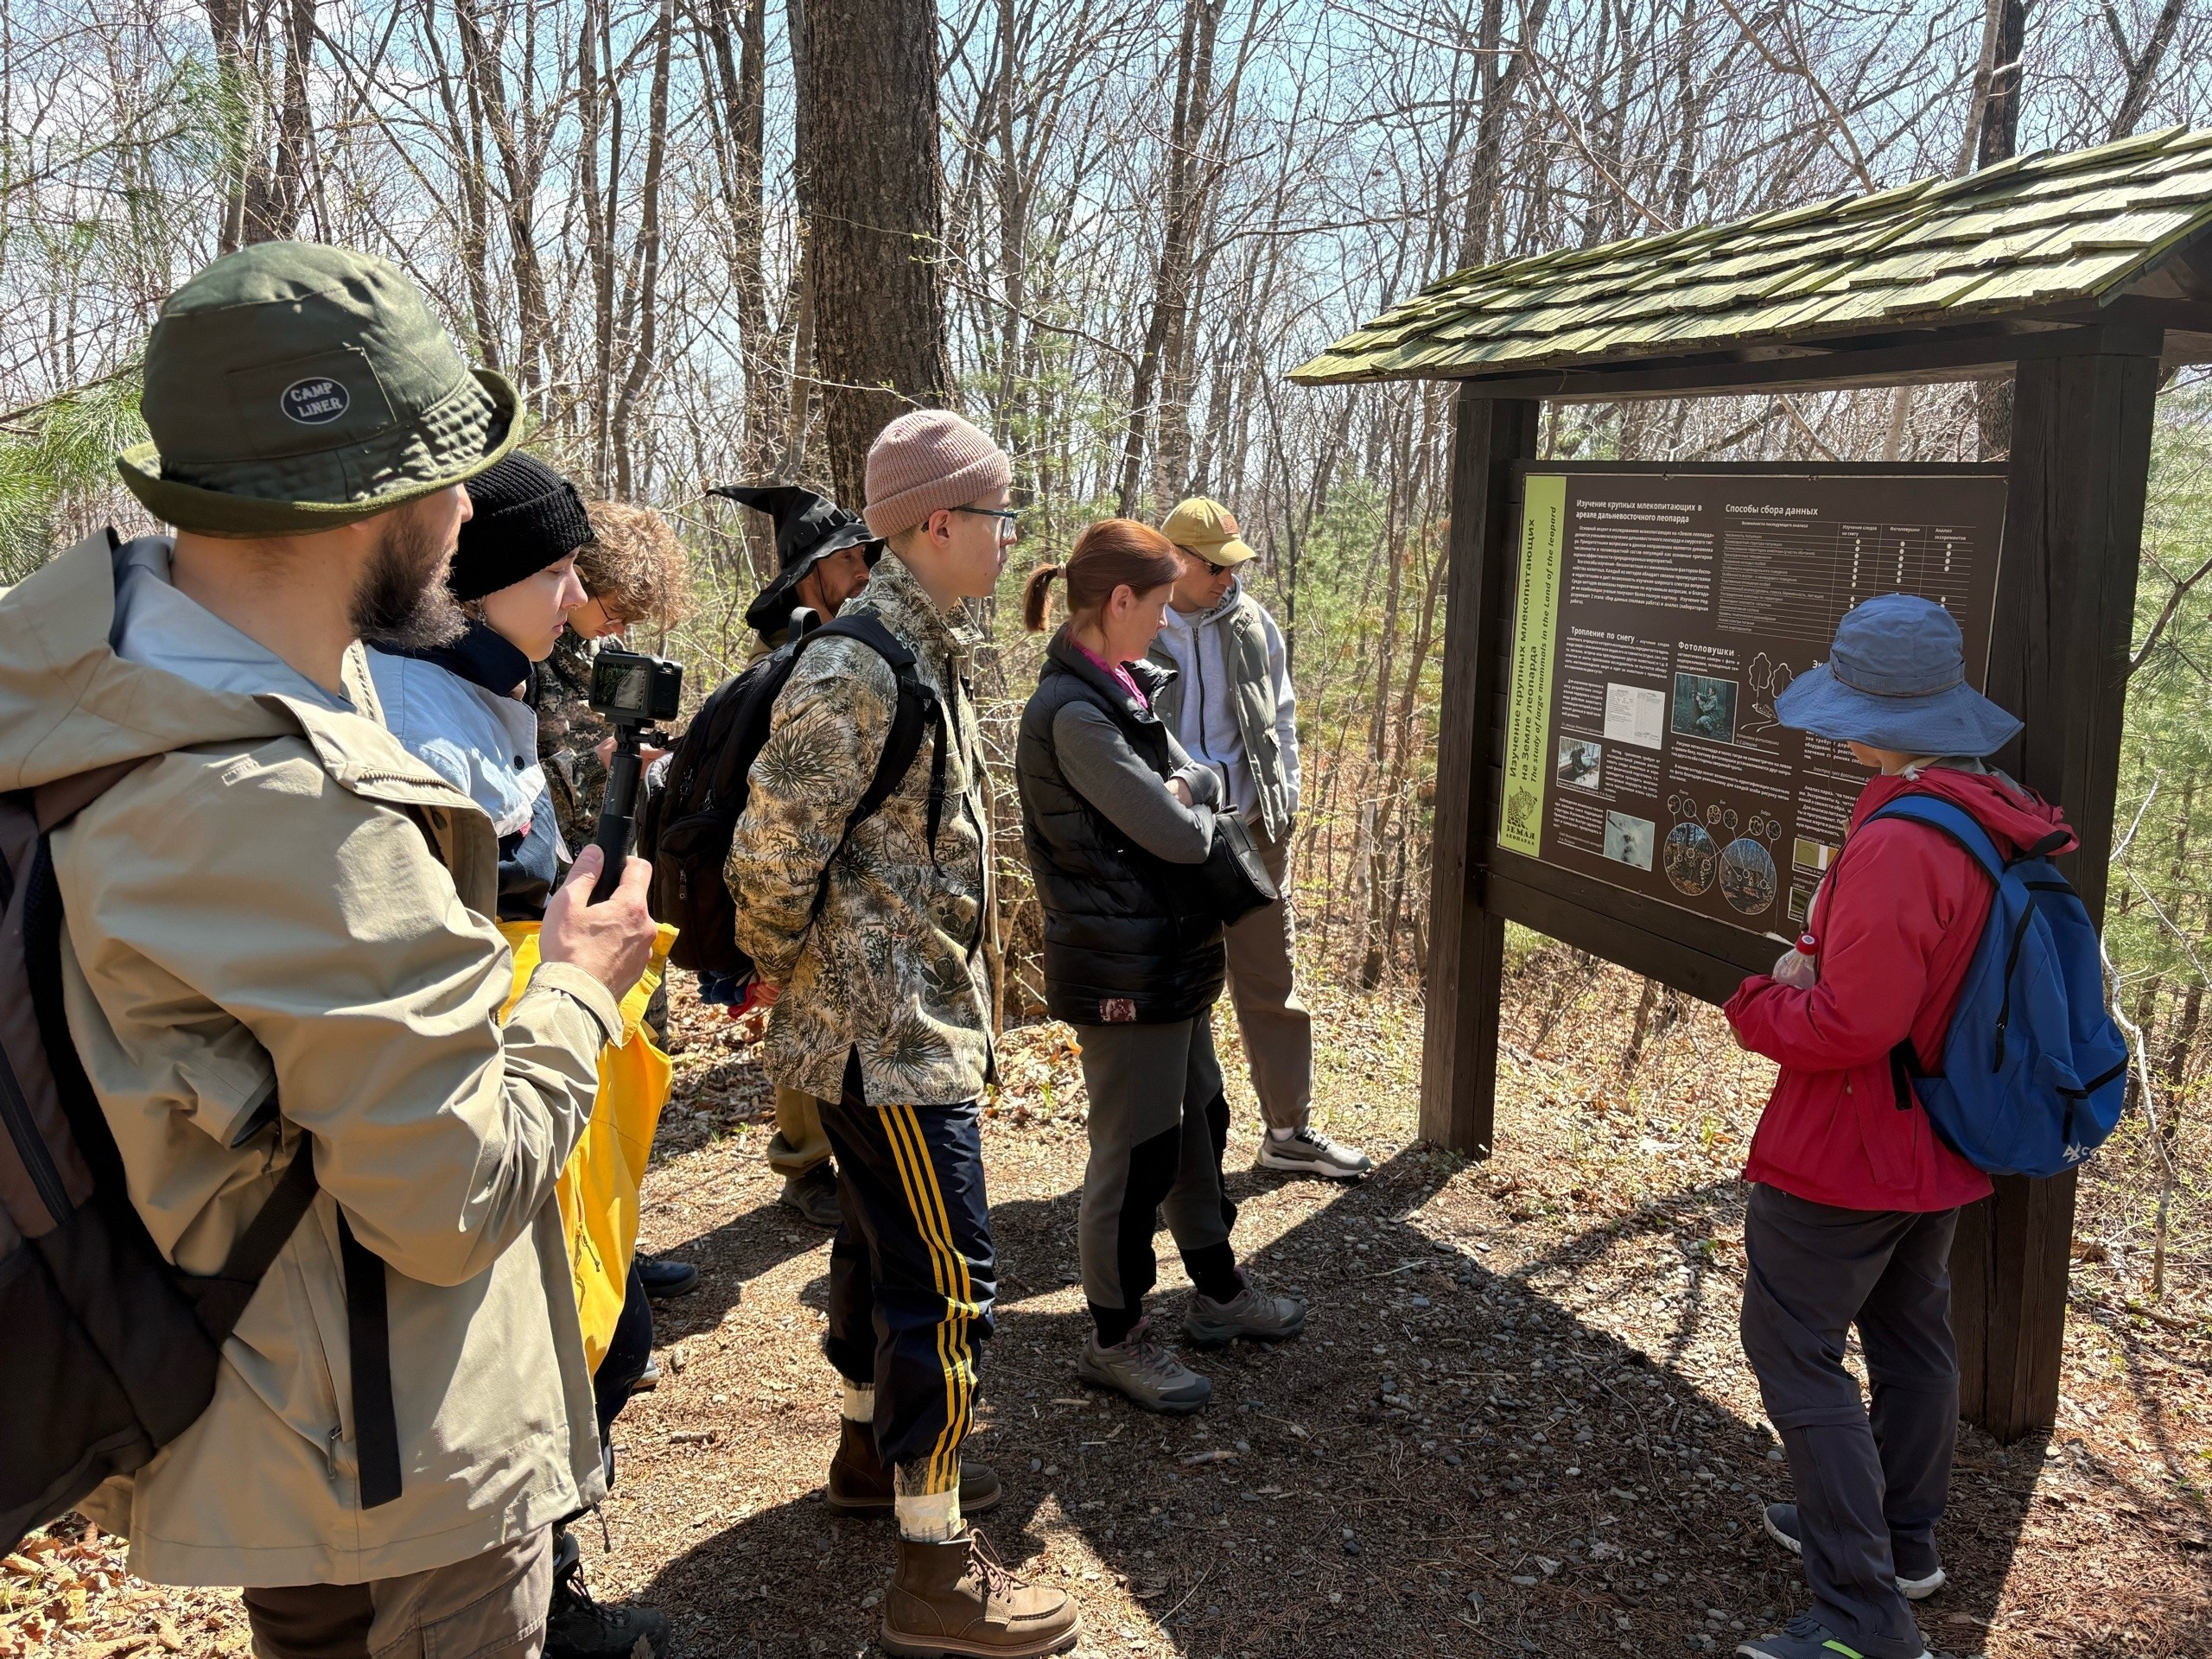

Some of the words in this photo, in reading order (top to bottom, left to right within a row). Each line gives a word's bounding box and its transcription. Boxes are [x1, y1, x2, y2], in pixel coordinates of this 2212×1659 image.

[291, 382, 332, 402] CAMP
[297, 398, 343, 417] LINER
[1576, 499, 1607, 510] Изучение
[1608, 502, 1635, 512] крупных
[1637, 503, 1695, 512] млекопитающих
[1726, 504, 1759, 513] Способы
[1761, 505, 1783, 516] сбора
[1785, 507, 1818, 516] данных
[1576, 512, 1597, 520] ареале
[1597, 513, 1655, 521] дальневосточного
[1657, 515, 1689, 524] леопарда
[1546, 569, 1553, 579] of
[1541, 631, 1547, 640] in
[1571, 626, 1605, 638] Тропление
[1616, 633, 1635, 644] снегу
[1510, 710, 1520, 777] Изучение
[1516, 646, 1525, 706] крупных
[1521, 519, 1535, 642] млекопитающих
[1678, 641, 1735, 656] Фотоловушки
[1527, 646, 1537, 713] леопарда
[1535, 695, 1544, 721] large
[1535, 723, 1542, 733] of
[1522, 717, 1532, 760] Земле
[1533, 736, 1541, 763] study
[1522, 764, 1528, 780] на
